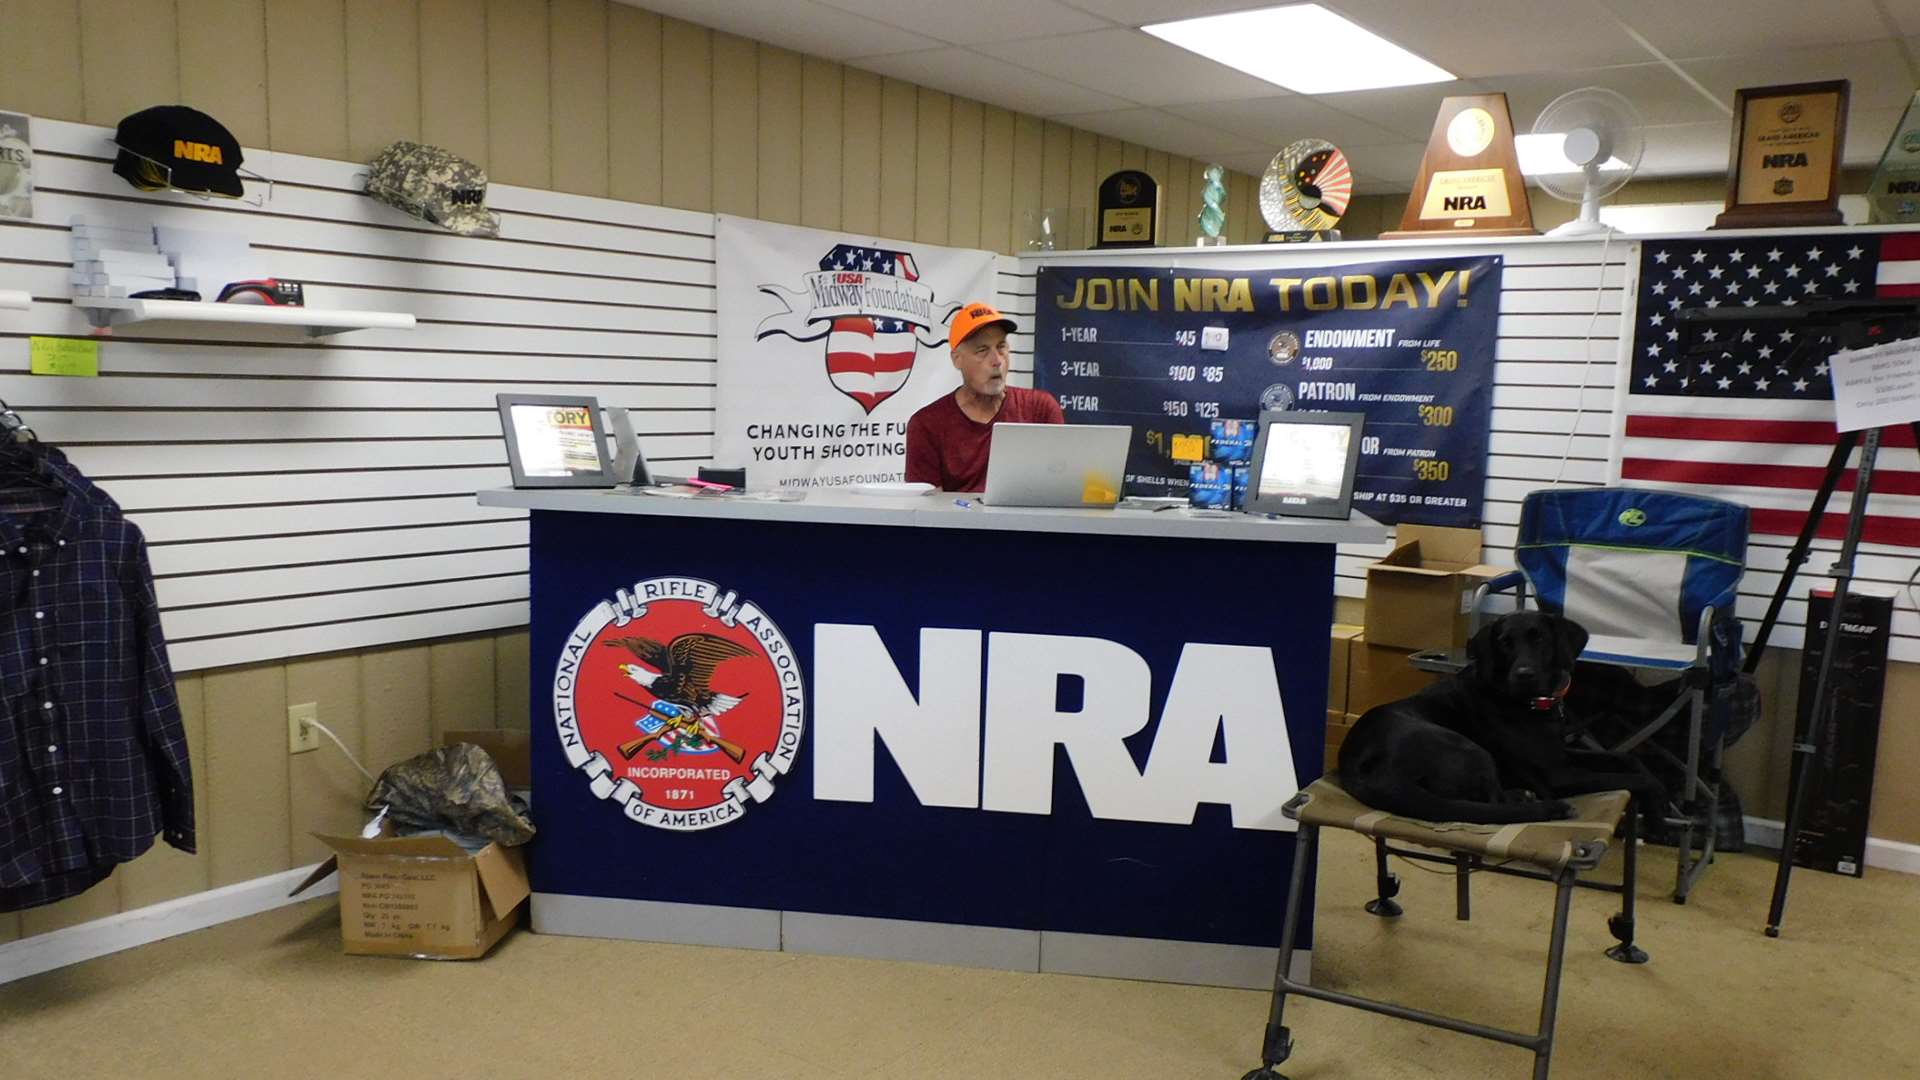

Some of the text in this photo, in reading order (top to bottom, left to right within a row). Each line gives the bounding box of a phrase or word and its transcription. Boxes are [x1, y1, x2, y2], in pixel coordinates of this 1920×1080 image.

[174, 139, 224, 165] NRA
[1762, 152, 1808, 169] NRA
[451, 188, 485, 205] NRA
[1444, 195, 1487, 211] NRA
[1109, 225, 1127, 233] NRA
[837, 273, 863, 284] USA
[1056, 269, 1472, 313] JOIN NRA TODAY!
[1061, 327, 1098, 343] 1-YEAR
[1175, 330, 1196, 346] $45
[1304, 328, 1442, 348] ENDOWMENT FROM LIFE
[1420, 350, 1458, 372] $250
[1061, 361, 1224, 382] 3-YEAR $100 $85
[1298, 382, 1356, 400] PATRON
[1358, 393, 1381, 402] FROM
[1060, 395, 1220, 418] 5-YEAR $150 $125
[1418, 404, 1453, 427] $300
[747, 423, 846, 440] CHANGING
[851, 423, 880, 438] THE
[752, 443, 906, 462] YOUTH SHOOTING
[1382, 448, 1406, 457] FROM
[1406, 448, 1437, 458] PATRON
[1412, 458, 1449, 481] $350
[1136, 475, 1166, 485] SHELLS
[1375, 492, 1388, 502] AT
[1409, 495, 1423, 504] OR
[1424, 496, 1467, 507] GREATER
[644, 581, 706, 599] RIFLE
[557, 629, 592, 748] NATIONAL
[746, 616, 801, 761] ASSOCIATION
[813, 623, 1299, 832] NRA
[627, 767, 731, 781] INCORPORATED
[665, 789, 695, 800] 1871
[632, 803, 740, 827] OF AMERICA
